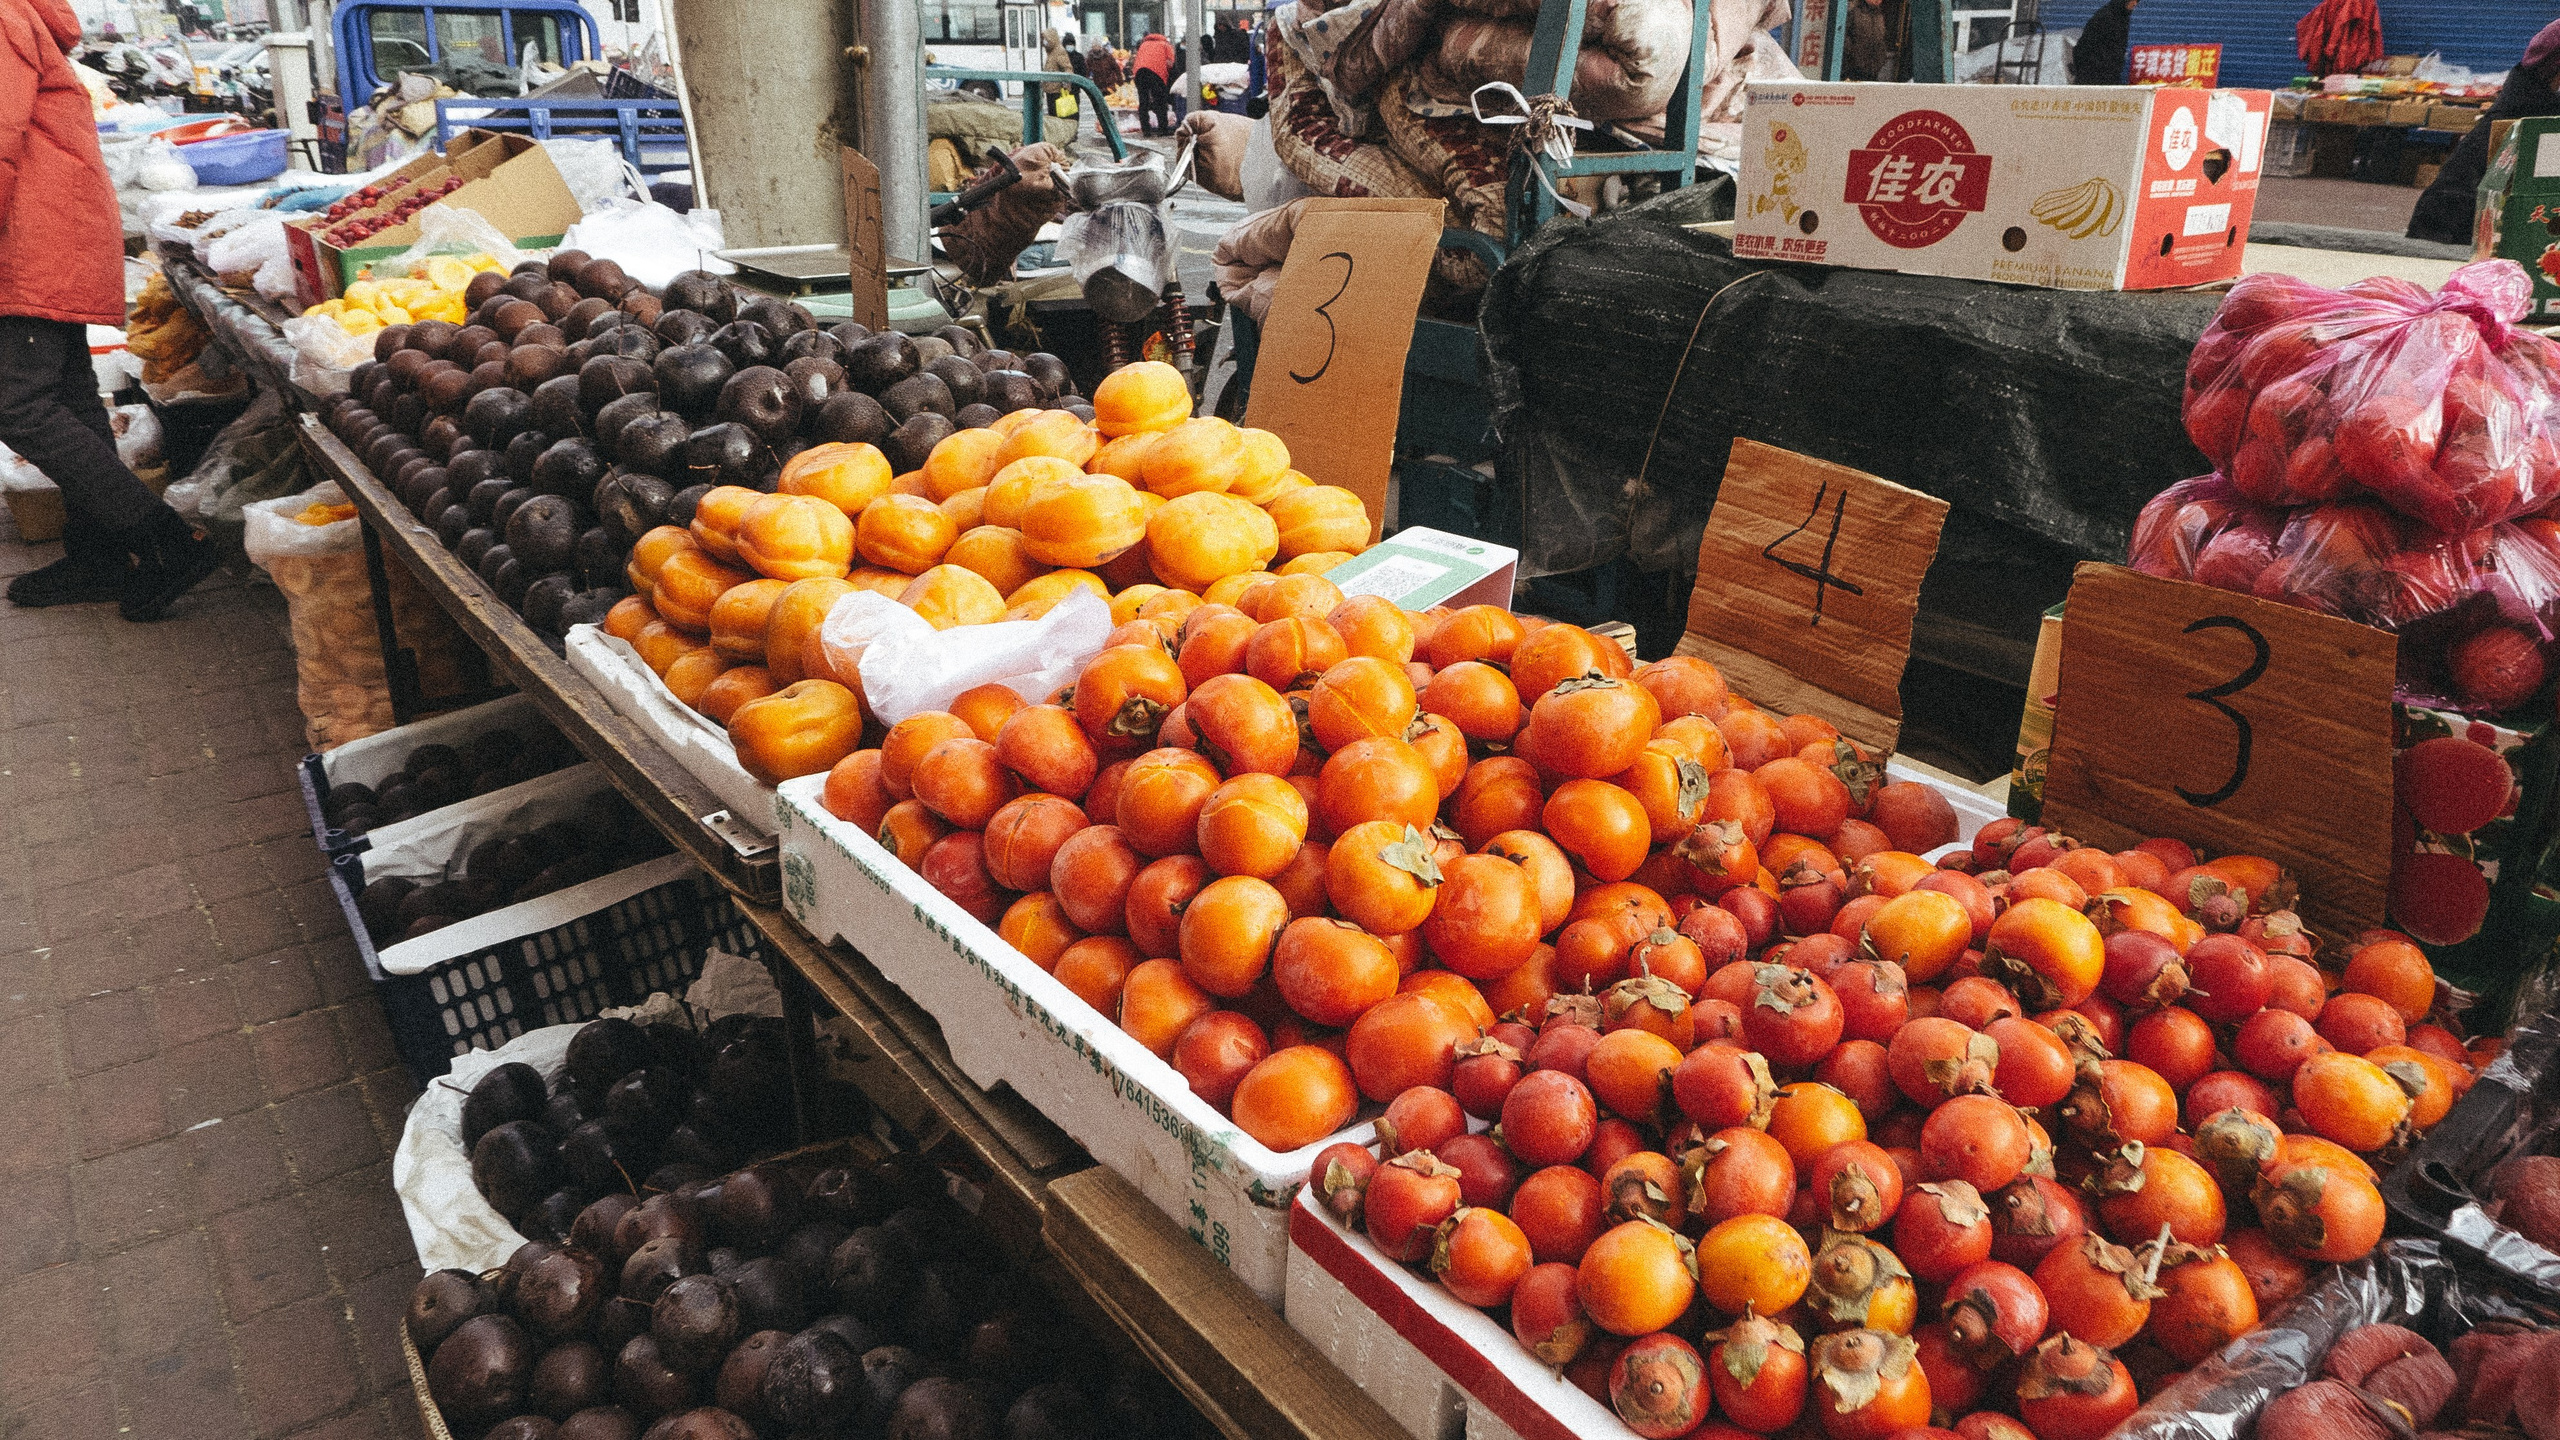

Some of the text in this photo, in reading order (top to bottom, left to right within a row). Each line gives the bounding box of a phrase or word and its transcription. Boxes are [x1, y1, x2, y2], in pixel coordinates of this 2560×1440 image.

[1866, 154, 1966, 207] 佳农
[1289, 251, 1353, 384] 3
[1992, 259, 2114, 280] PREMIUM BANANA
[1762, 480, 1863, 626] 4
[2173, 615, 2271, 807] 3
